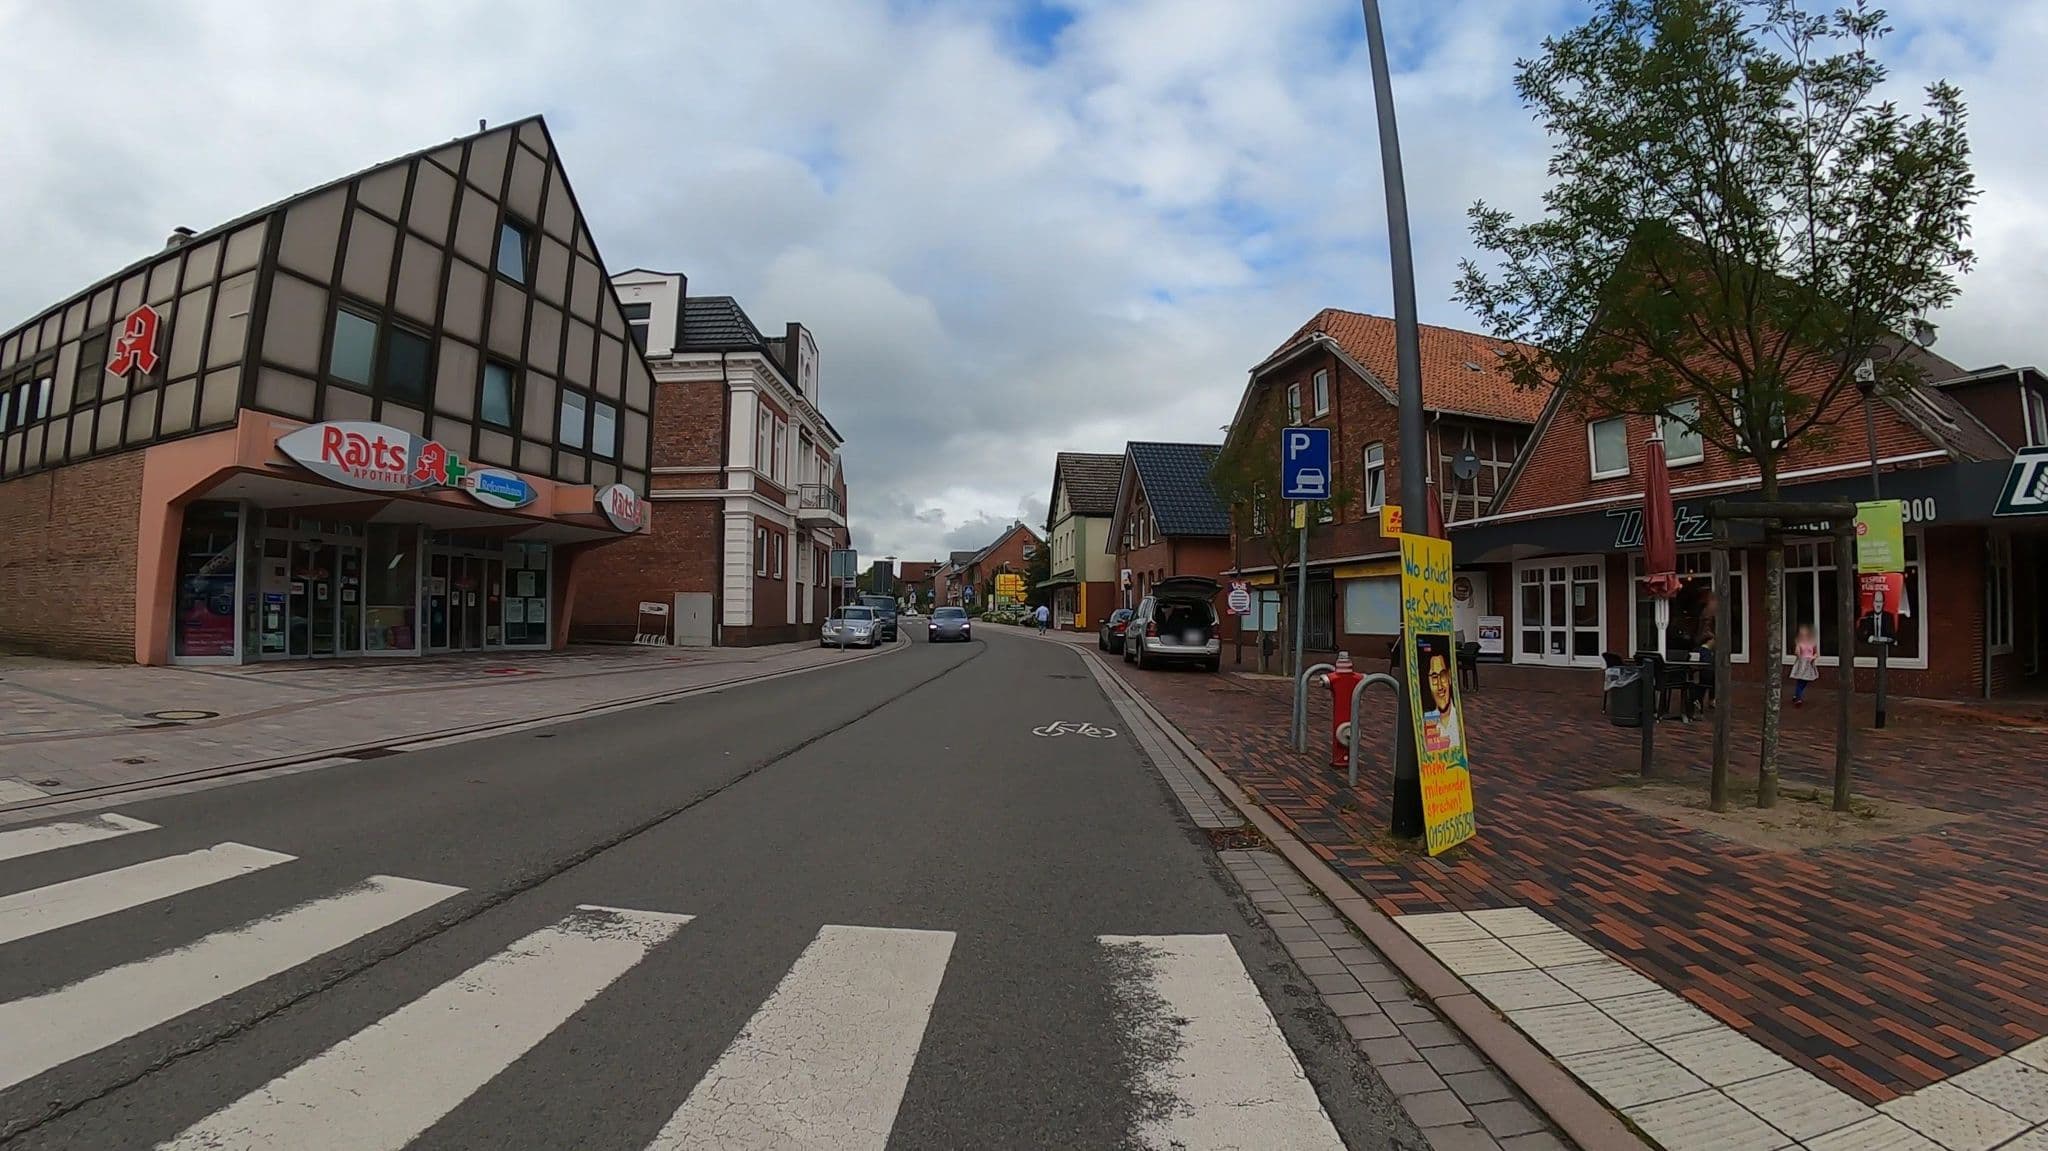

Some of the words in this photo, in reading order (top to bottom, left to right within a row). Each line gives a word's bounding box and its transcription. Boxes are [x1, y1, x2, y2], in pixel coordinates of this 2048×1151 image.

[1290, 433, 1310, 459] P
[353, 467, 413, 486] APOTHEKE
[1401, 539, 1420, 577] Wo
[1424, 546, 1451, 586] drückt
[1405, 583, 1420, 612] der
[1423, 588, 1453, 617] Schuh?
